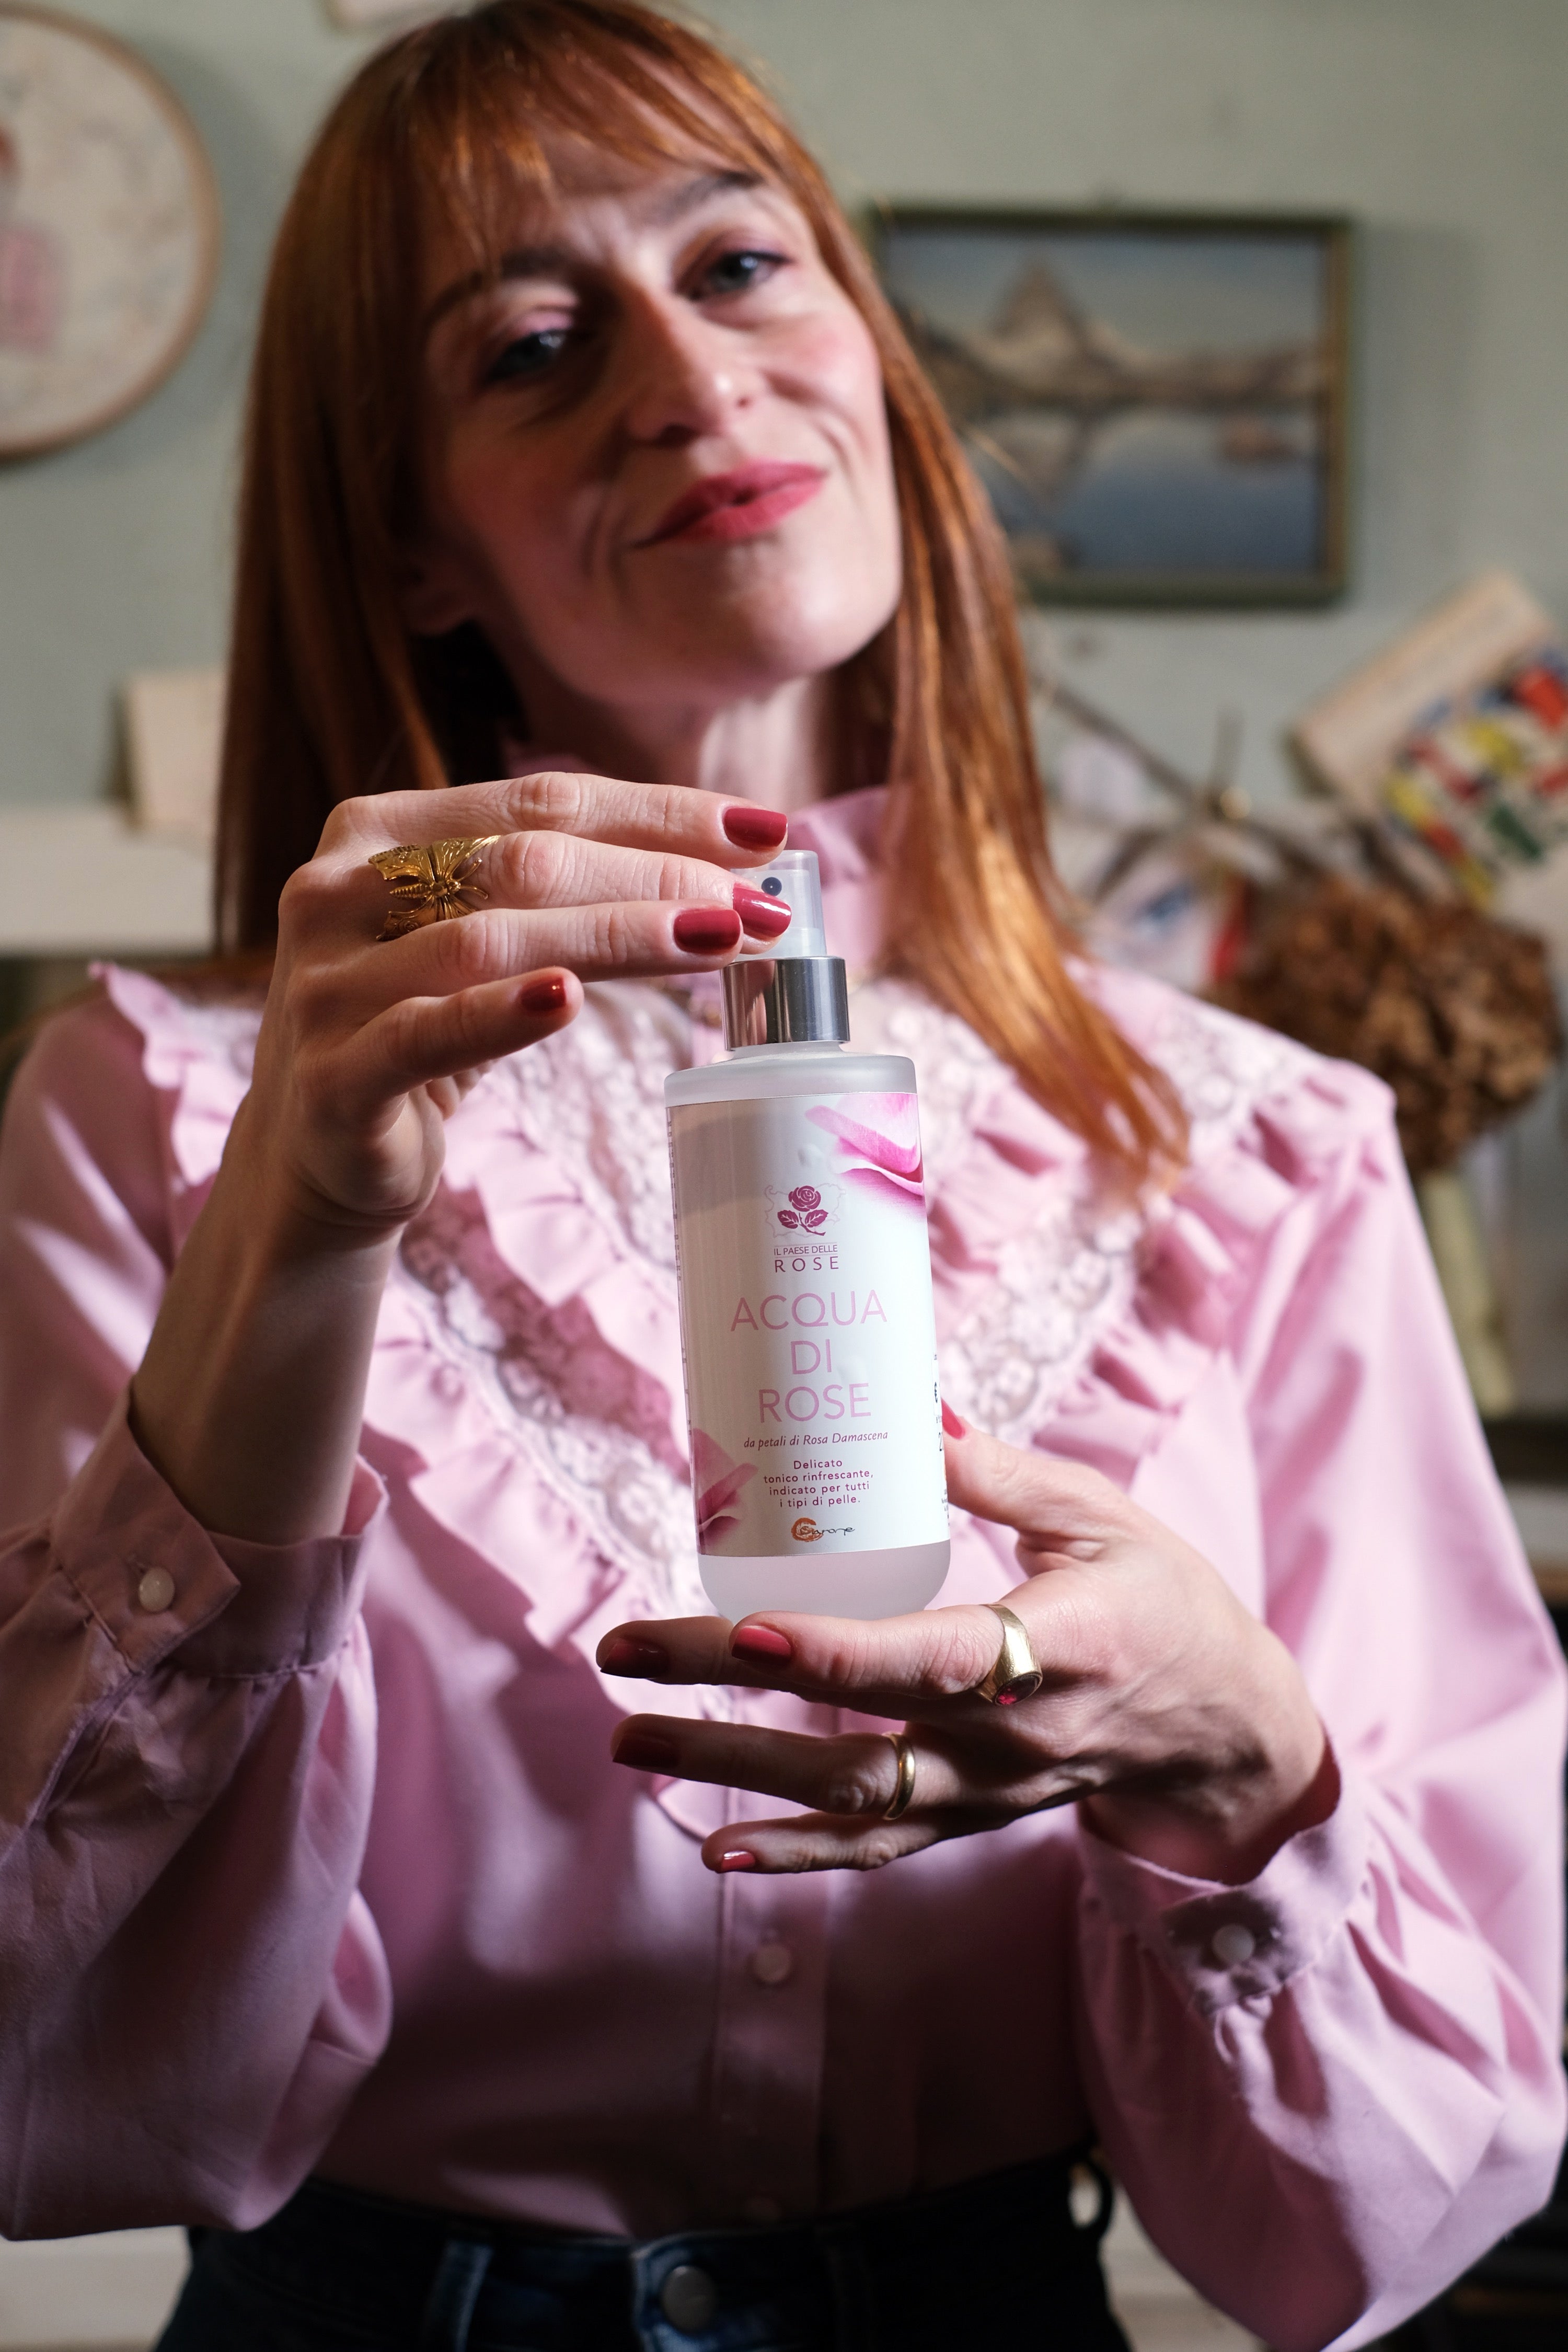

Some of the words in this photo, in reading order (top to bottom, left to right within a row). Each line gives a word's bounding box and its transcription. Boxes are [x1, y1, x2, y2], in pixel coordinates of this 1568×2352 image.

[775, 1256, 838, 1273] ROSE
[731, 1289, 887, 1332] ACQUA
[791, 1339, 832, 1375] DI
[759, 1382, 871, 1423] ROSE
[744, 1438, 754, 1448] da
[758, 1436, 786, 1450] petali
[790, 1435, 799, 1445] di
[803, 1435, 828, 1445] Rosa
[832, 1432, 888, 1443] Damascena
[794, 1460, 843, 1469] Delicato
[764, 1474, 798, 1483] tonico
[803, 1470, 873, 1481] rinfrescante,
[769, 1486, 816, 1495] indicato
[822, 1485, 840, 1494] per
[846, 1481, 869, 1491] tutti
[788, 1498, 806, 1508] tipi
[813, 1497, 822, 1506] di
[828, 1495, 860, 1507] pelle.
